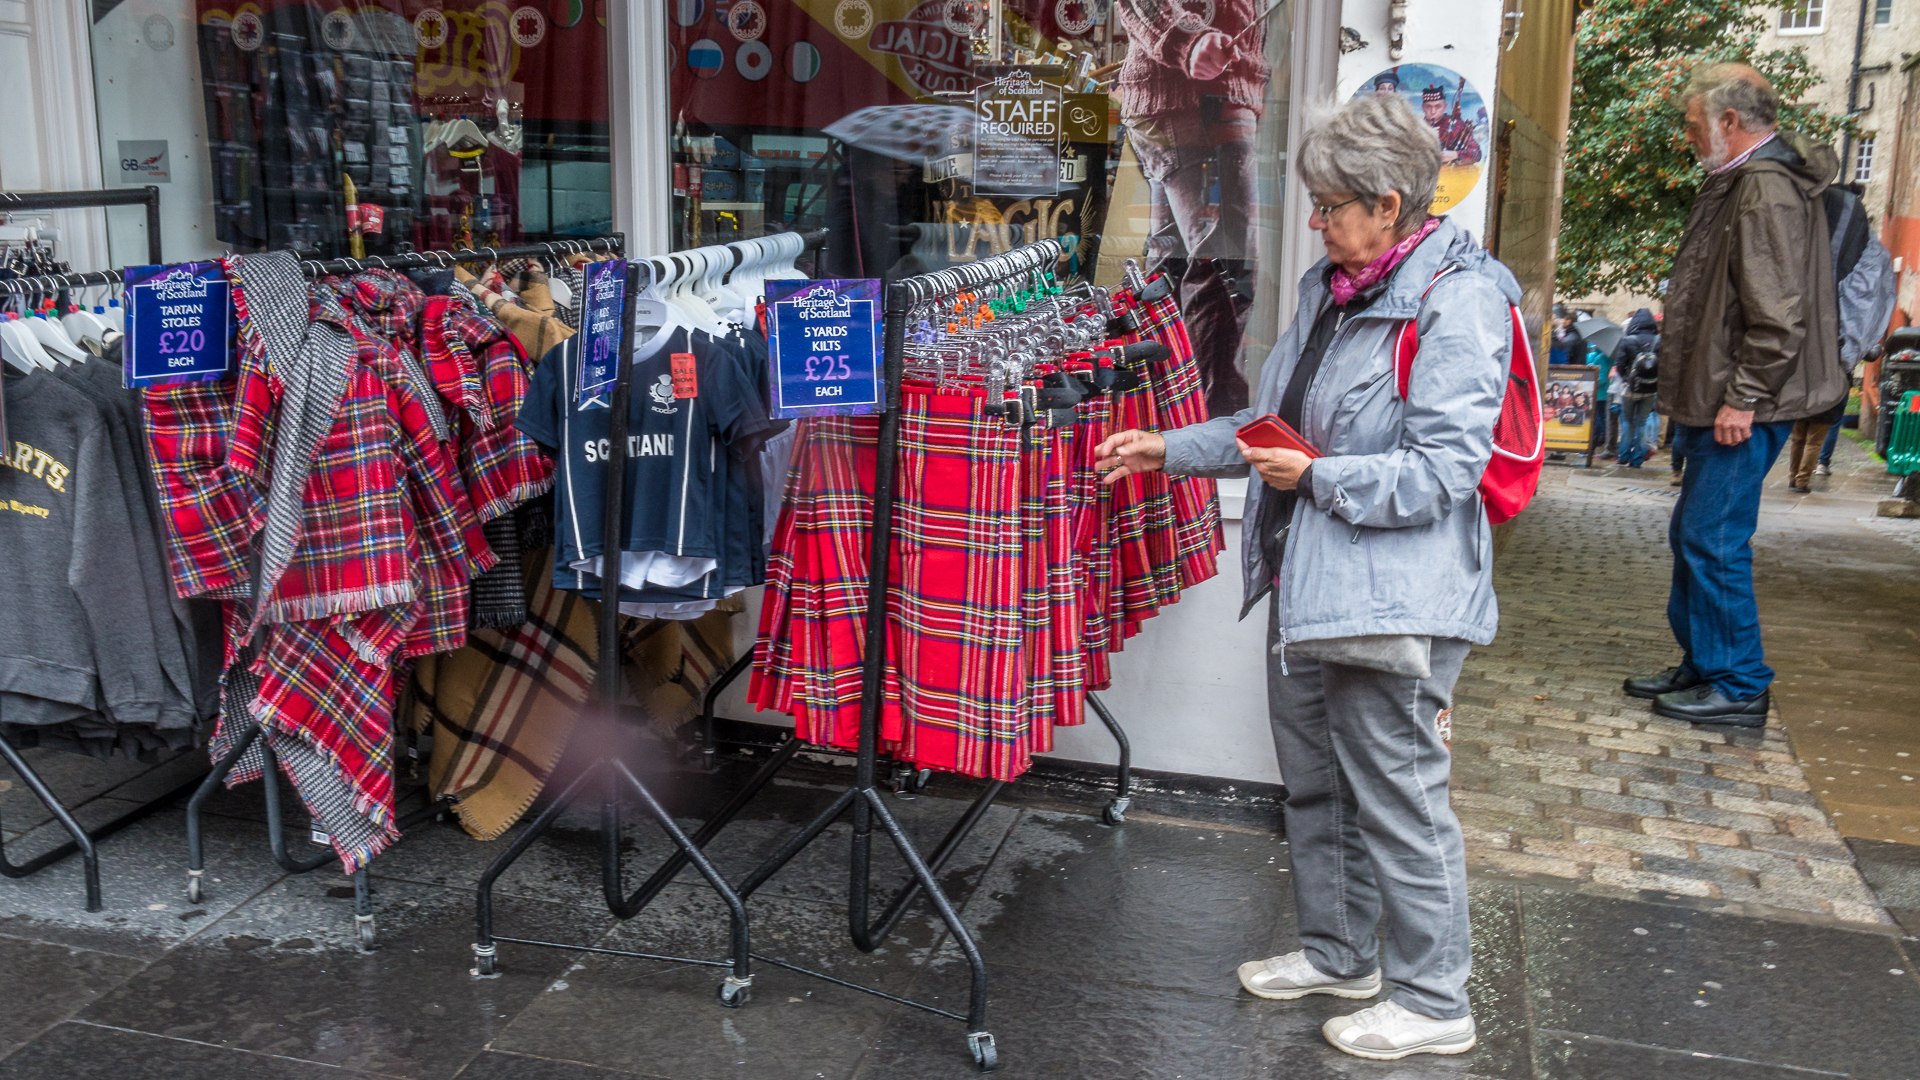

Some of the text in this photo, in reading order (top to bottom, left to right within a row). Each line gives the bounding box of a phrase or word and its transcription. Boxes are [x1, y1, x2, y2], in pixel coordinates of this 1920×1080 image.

[993, 76, 1030, 88] Heritage
[999, 86, 1043, 96] of Scotland
[981, 100, 1056, 122] STAFF
[980, 122, 1056, 136] REQUIRED
[932, 198, 1079, 262] MAGIC
[151, 279, 192, 291] Heritage
[156, 288, 207, 301] of Scotland
[793, 296, 834, 309] Heritage
[160, 304, 203, 316] TARTAN
[799, 307, 851, 320] of Scotland
[161, 316, 201, 329] STOLES
[804, 326, 848, 337] 5 YARDS
[159, 329, 205, 354] £20
[812, 340, 841, 351] KILTS
[593, 335, 610, 362] £10
[167, 357, 194, 367] EACH
[805, 354, 851, 381] £25
[815, 386, 842, 397] EACH
